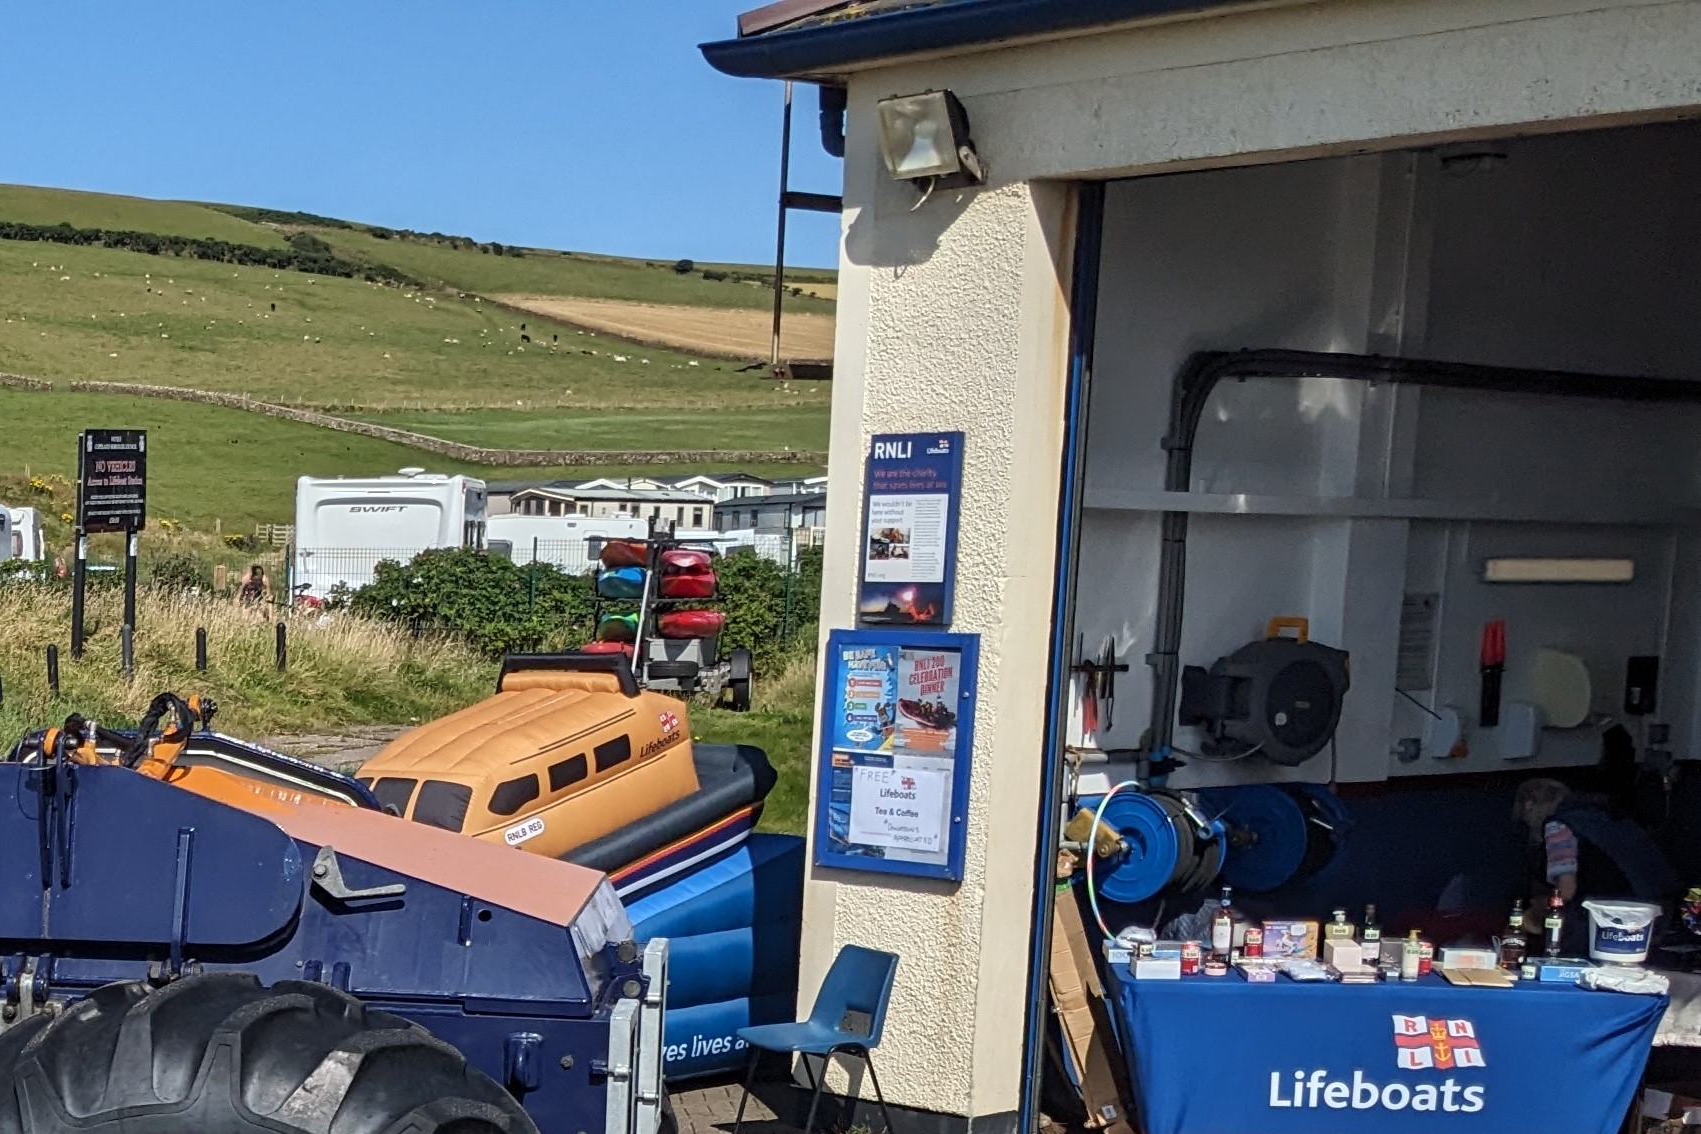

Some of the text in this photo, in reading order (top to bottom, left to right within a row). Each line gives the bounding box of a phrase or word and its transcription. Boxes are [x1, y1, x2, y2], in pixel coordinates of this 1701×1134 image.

[874, 441, 912, 459] RNLI
[909, 666, 953, 685] CELEBRATION
[639, 729, 680, 758] Lifeboats
[880, 789, 916, 800] Lifeboats
[875, 806, 919, 818] Tea & Coffee
[1558, 970, 1579, 978] JIGSA
[691, 1034, 733, 1058] lives
[1269, 1070, 1484, 1112] Lifeboats
